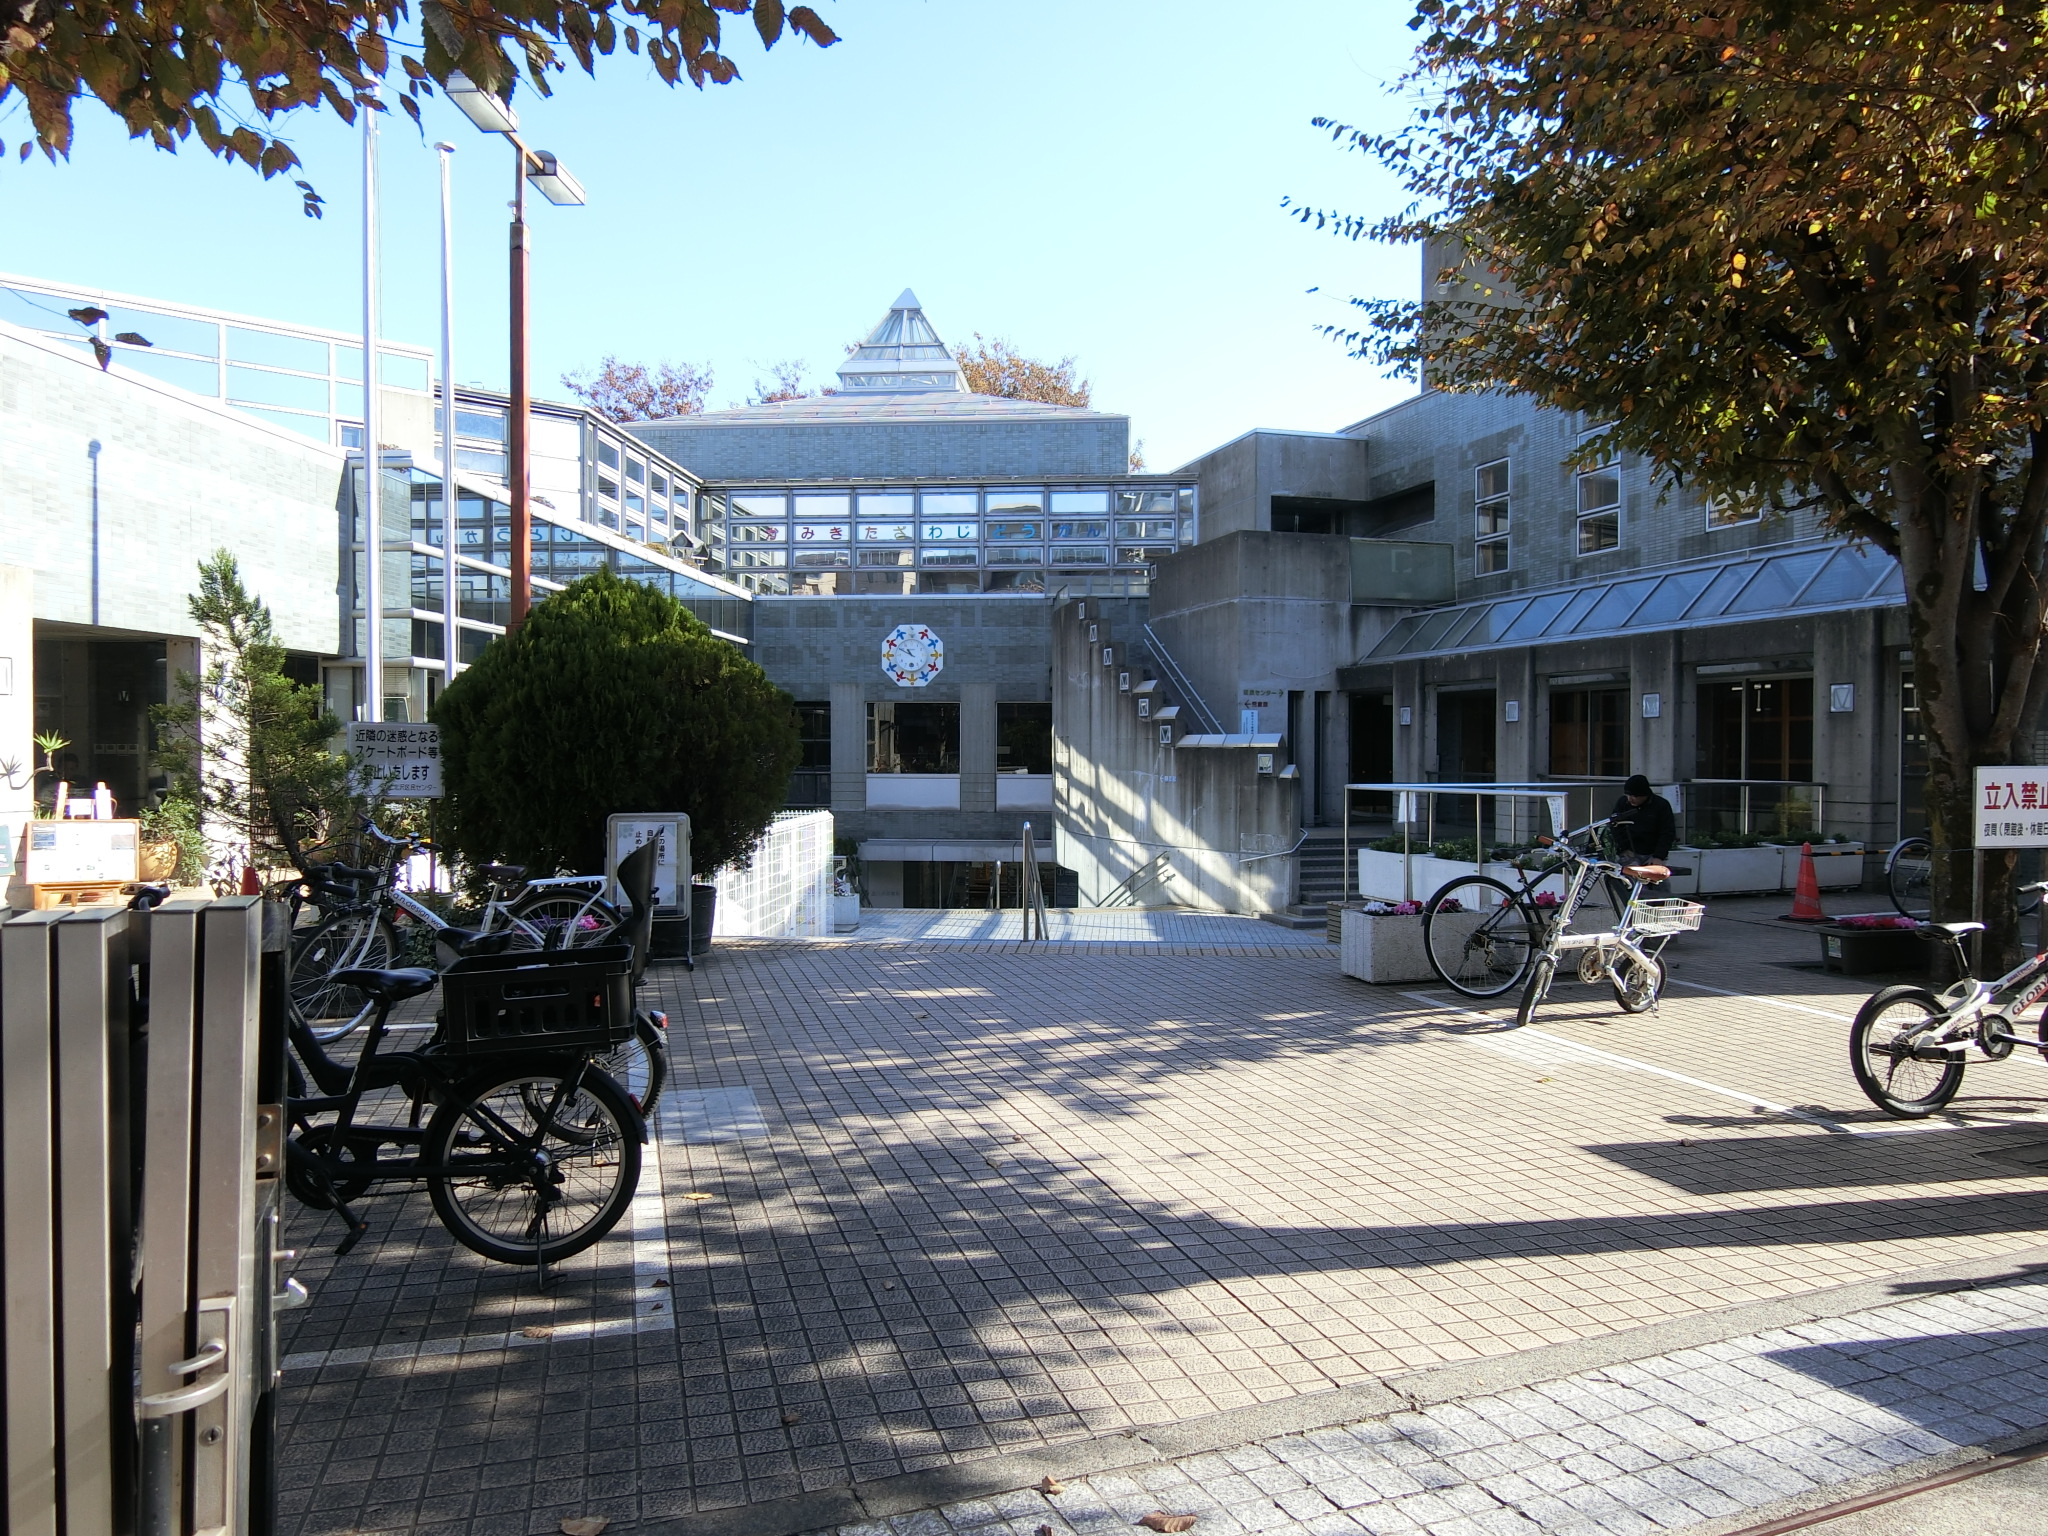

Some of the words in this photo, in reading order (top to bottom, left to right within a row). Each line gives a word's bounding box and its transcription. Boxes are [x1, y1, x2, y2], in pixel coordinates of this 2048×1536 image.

[355, 728, 438, 743] 近隣の迷惑となる
[355, 745, 438, 760] スケートボード等
